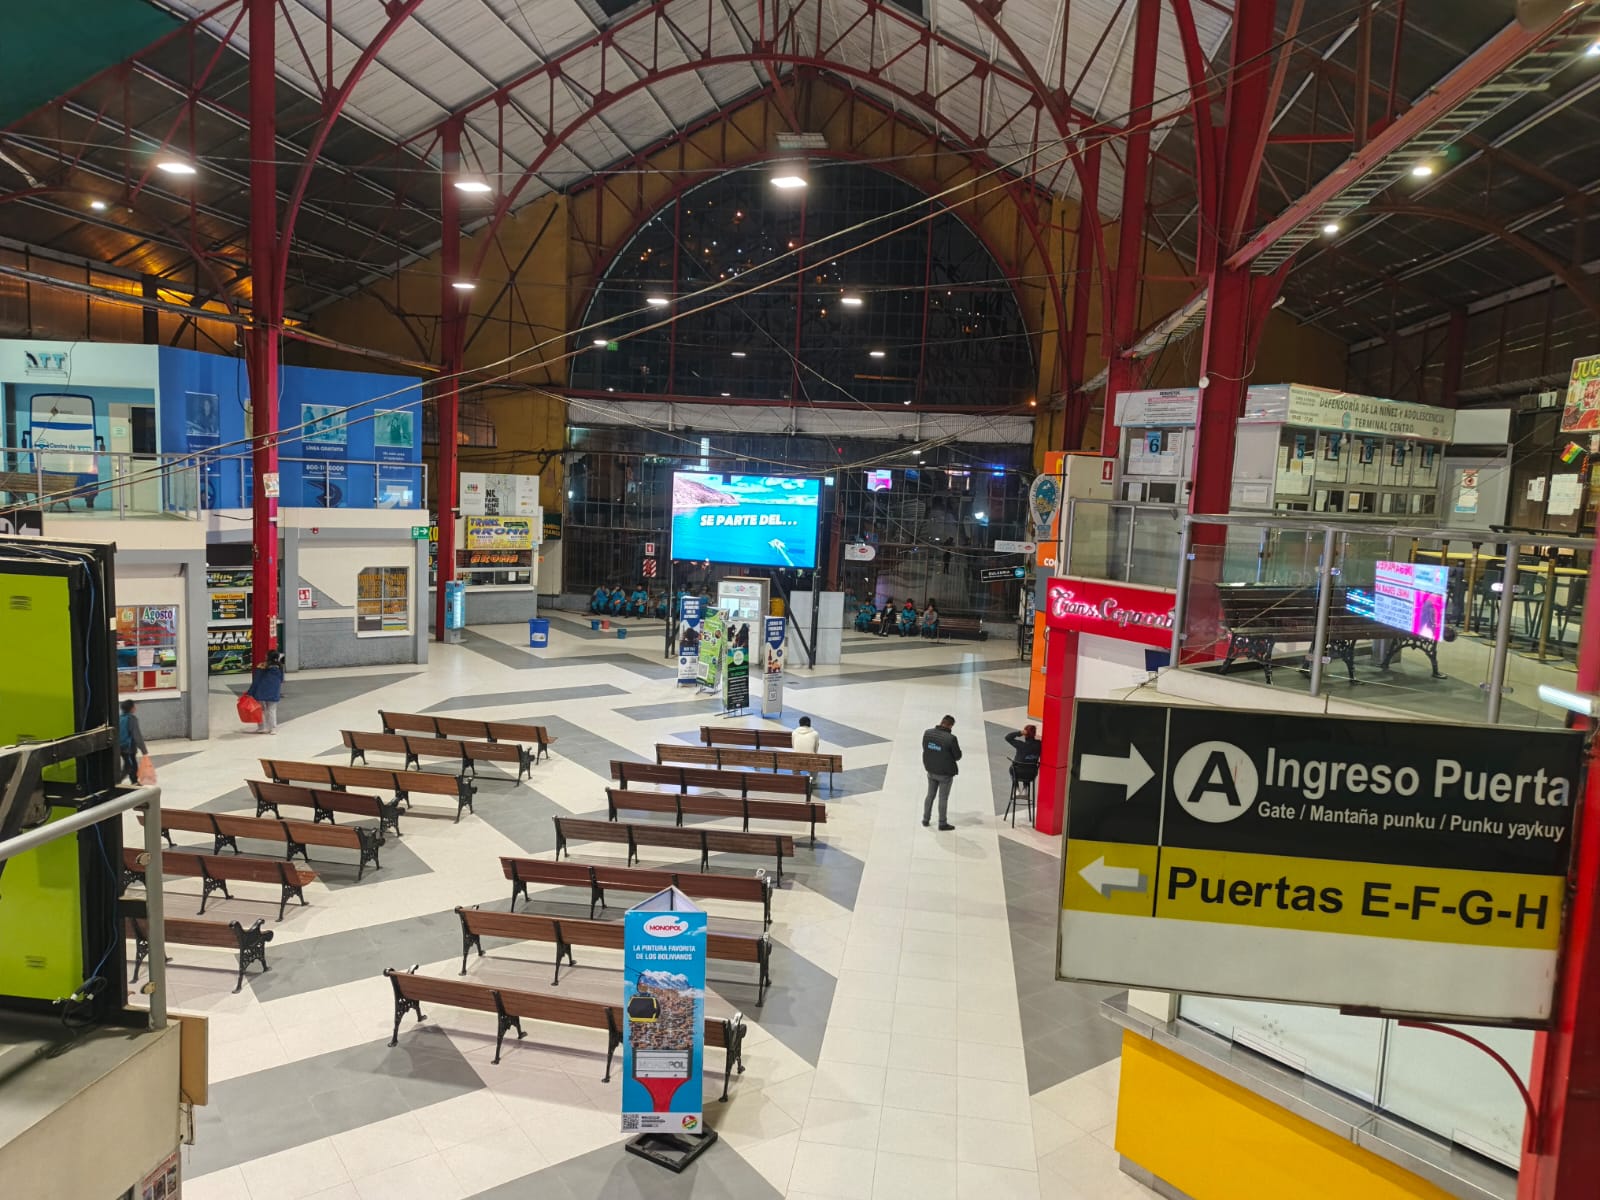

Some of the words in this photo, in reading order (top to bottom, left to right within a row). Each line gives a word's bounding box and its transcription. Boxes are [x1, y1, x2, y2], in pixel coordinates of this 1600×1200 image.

[1319, 398, 1359, 412] DEFENSORÍA
[1360, 404, 1370, 413] DE
[1370, 405, 1378, 414] LA
[1379, 404, 1399, 417] NIÑEZ
[1404, 409, 1445, 424] ADOLESCENCIA
[1354, 417, 1388, 431] TERMINAL
[1389, 422, 1414, 433] CENTRO
[1149, 438, 1160, 453] 6
[469, 527, 530, 536] AROMA
[700, 514, 714, 527] SE
[716, 514, 757, 527] PARTE
[758, 514, 798, 527] DEL...
[143, 606, 174, 624] Agosto
[1186, 750, 1242, 807] A
[1265, 747, 1420, 800] Ingreso
[1433, 758, 1570, 807] Puerta
[1257, 801, 1296, 821] Gate
[1299, 805, 1307, 821] /
[1309, 805, 1379, 826] Mantaña
[1383, 812, 1436, 831] punku
[1439, 814, 1447, 831] /
[1450, 815, 1503, 835] Punku
[1507, 822, 1565, 842] yaykuy
[1167, 866, 1344, 914] Puertas
[1360, 881, 1550, 930] E-F-G-H
